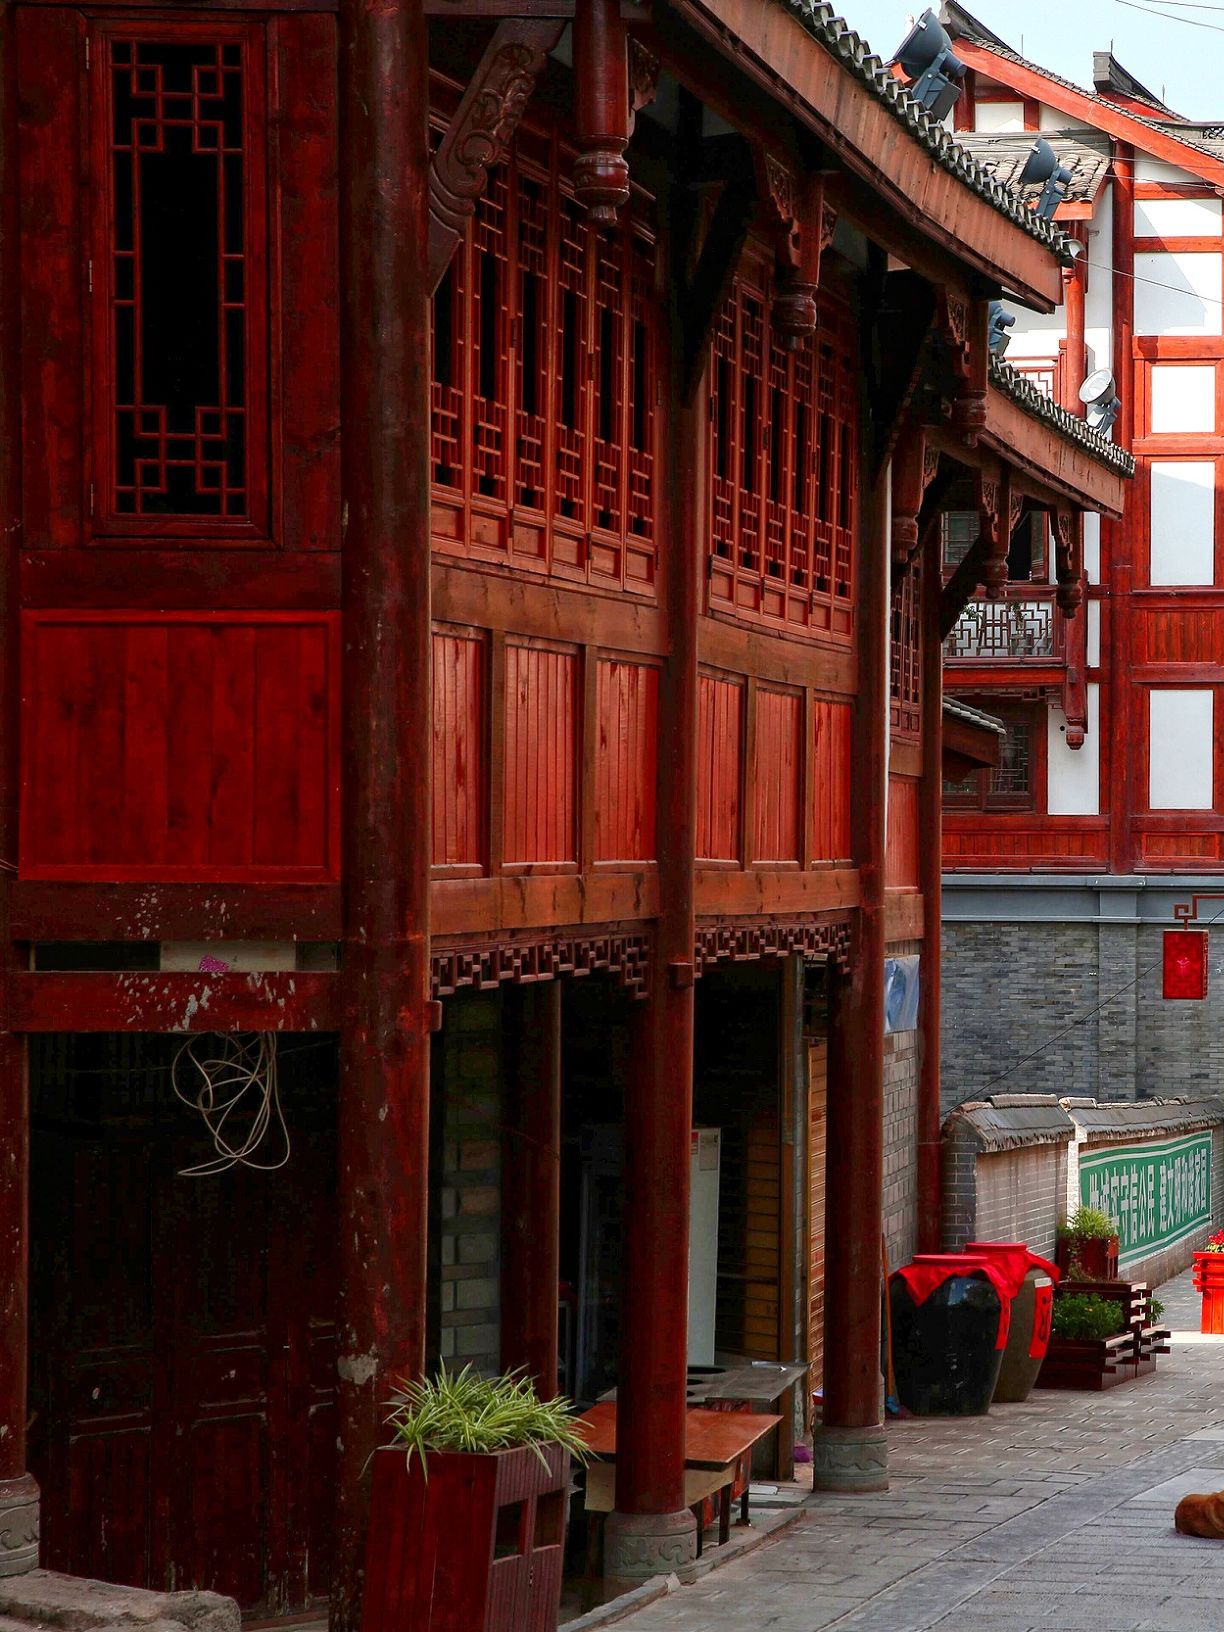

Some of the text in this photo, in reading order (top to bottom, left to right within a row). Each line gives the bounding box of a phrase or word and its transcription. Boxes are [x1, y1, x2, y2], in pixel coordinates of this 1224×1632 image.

[1159, 1148, 1207, 1233] 建文明和谐家园
